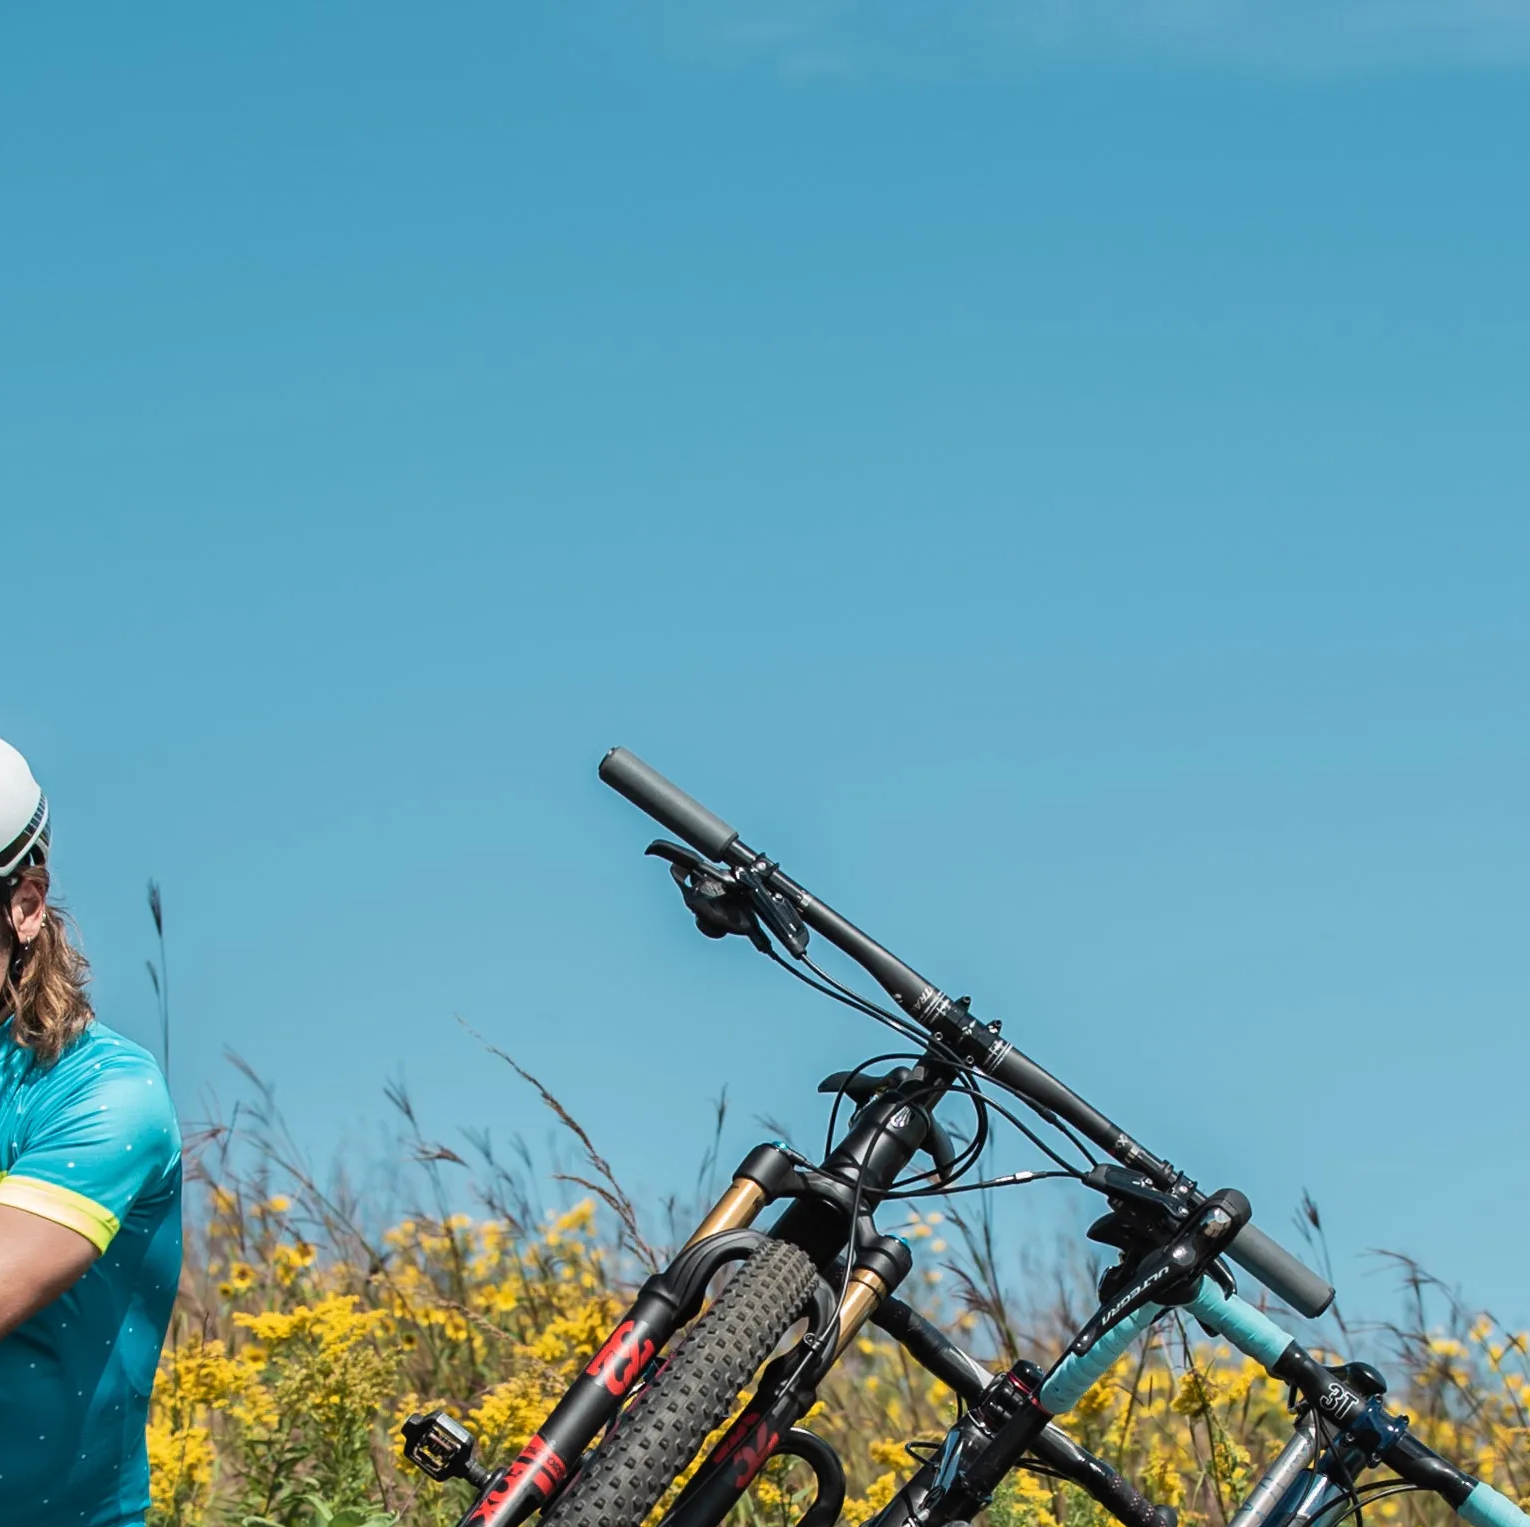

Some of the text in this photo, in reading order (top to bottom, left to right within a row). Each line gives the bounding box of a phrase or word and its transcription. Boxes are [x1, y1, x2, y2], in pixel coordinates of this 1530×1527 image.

[1101, 1266, 1170, 1326] ULTEGRA
[585, 1319, 655, 1396] 32
[1319, 1382, 1360, 1420] 3T
